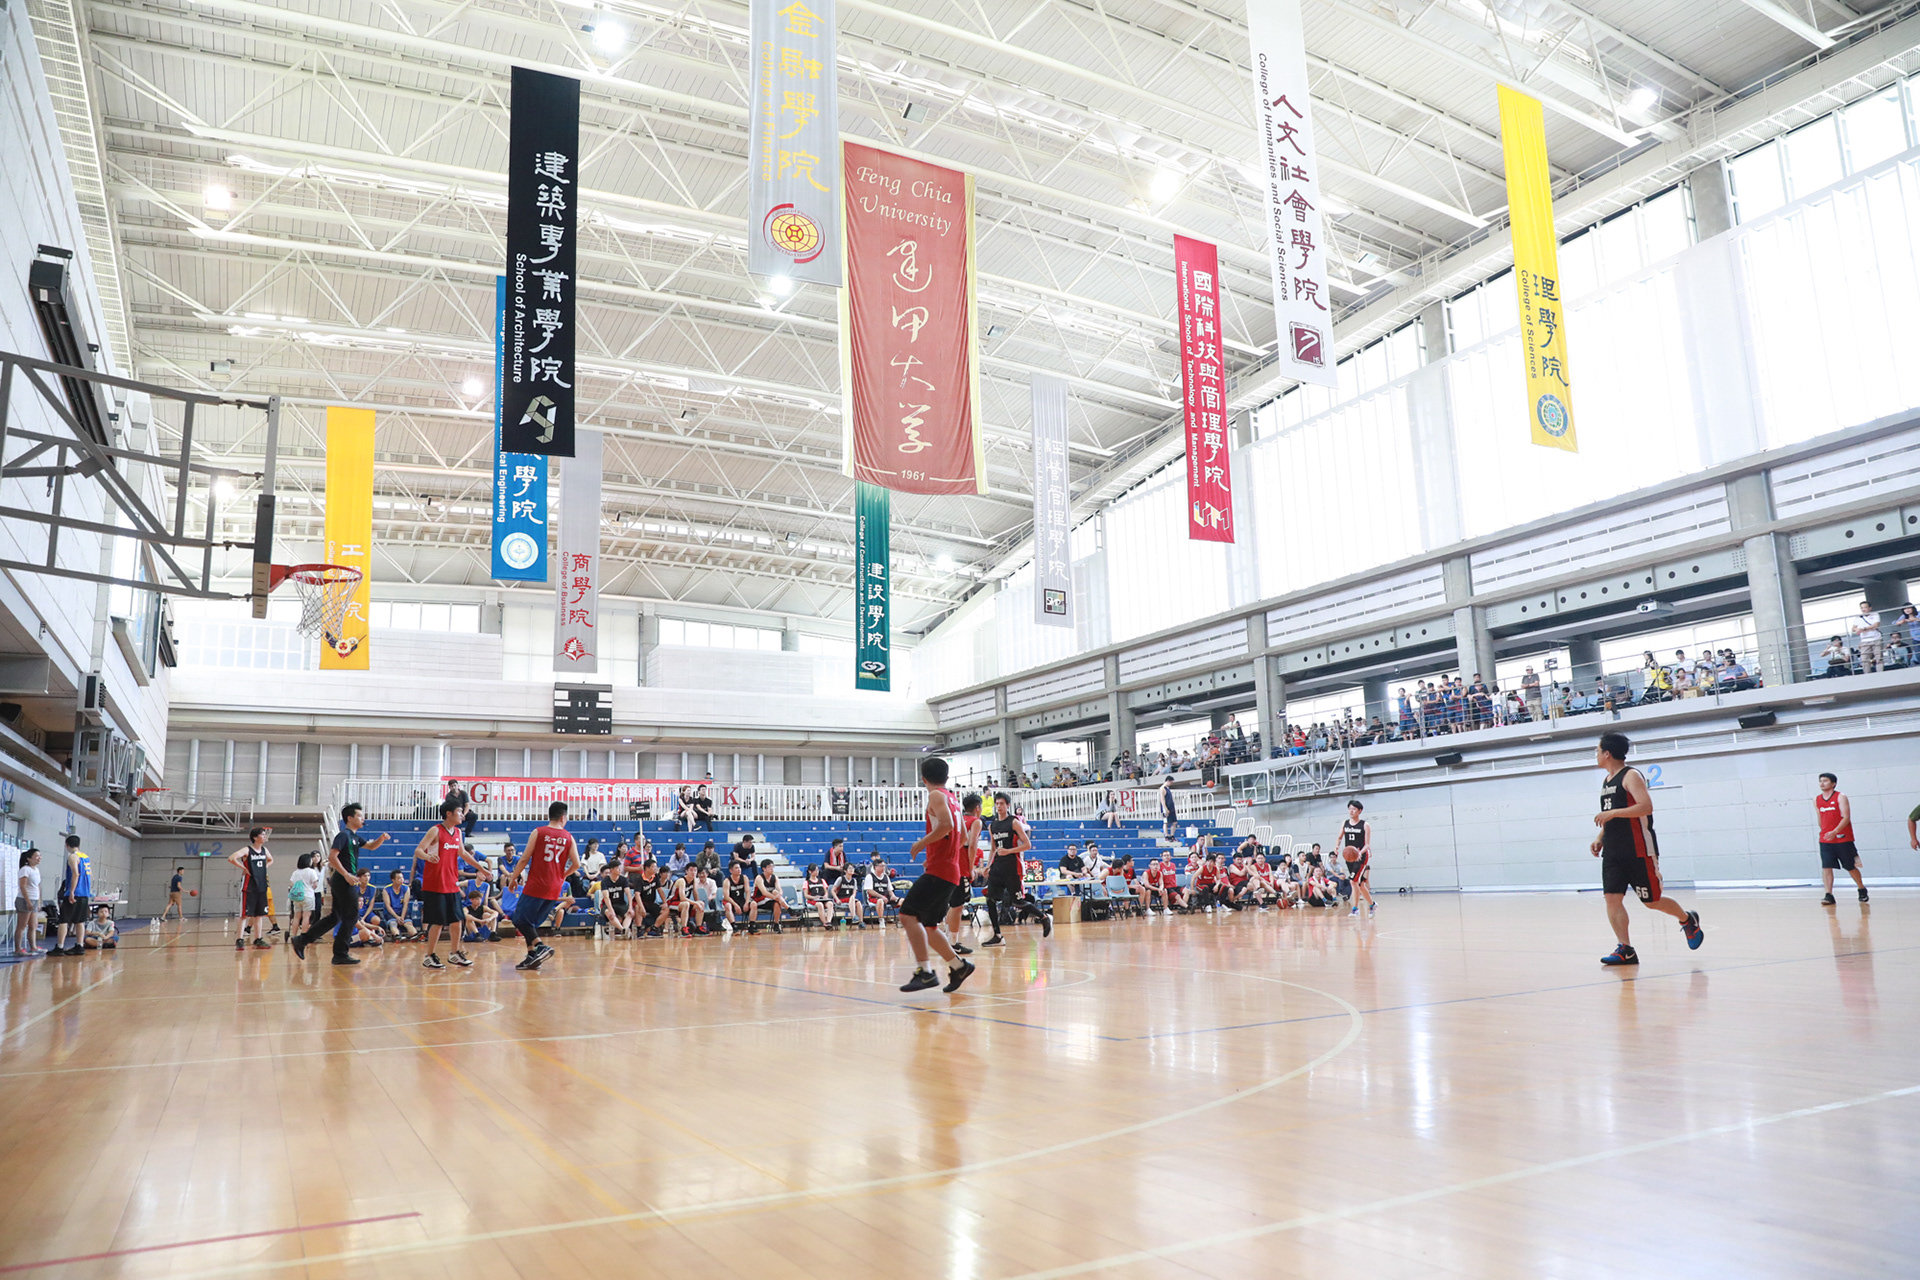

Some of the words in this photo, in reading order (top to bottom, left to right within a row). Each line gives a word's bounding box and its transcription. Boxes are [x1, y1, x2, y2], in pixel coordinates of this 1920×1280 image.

[760, 41, 775, 96] College
[1258, 52, 1269, 95] College
[762, 101, 775, 118] of
[1263, 98, 1272, 111] of
[762, 122, 775, 181] Finance
[1264, 114, 1277, 179] Humanities
[856, 165, 901, 196] Feng
[910, 181, 953, 203] Chia
[1270, 182, 1281, 205] and
[860, 194, 952, 237] University
[1273, 207, 1285, 244] Social
[515, 253, 527, 293] School
[1181, 260, 1191, 311] International
[1277, 247, 1288, 301] Sciences
[1521, 269, 1531, 311] College
[514, 296, 526, 309] of
[1526, 314, 1533, 326] of
[513, 310, 526, 383] Architecture
[1184, 313, 1193, 343] School
[1532, 273, 1569, 388] 理學院
[1186, 345, 1194, 356] of
[1526, 328, 1537, 379] Sciences
[1187, 359, 1195, 407] Technology
[1189, 412, 1198, 428] and
[900, 469, 926, 481] 1961
[1191, 433, 1200, 487] Management
[497, 469, 508, 523] Engineering
[560, 551, 569, 580] College
[561, 581, 568, 590] of
[569, 553, 594, 628] 商學院
[560, 591, 568, 627] Business
[470, 782, 489, 804] G
[722, 786, 740, 806] K
[1118, 790, 1130, 807] P
[543, 843, 565, 864] 57
